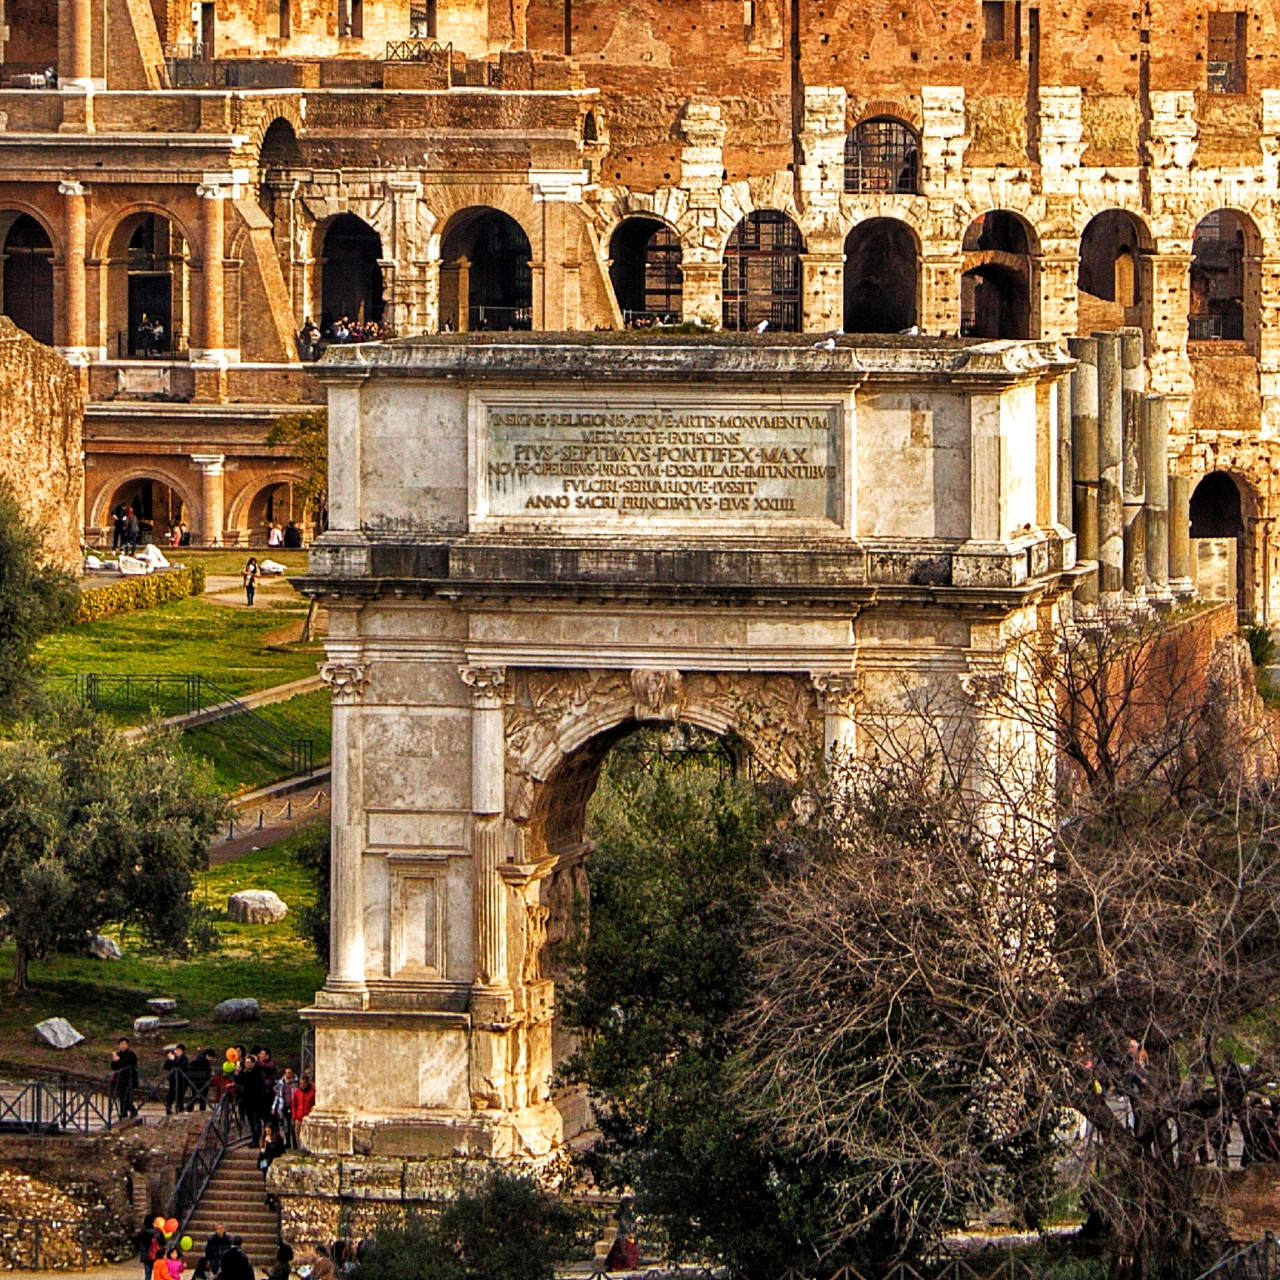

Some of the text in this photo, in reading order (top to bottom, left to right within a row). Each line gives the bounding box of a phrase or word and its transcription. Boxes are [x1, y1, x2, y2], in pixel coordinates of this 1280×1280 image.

[492, 413, 829, 430] INSIGNE RELIGIONIS ATQVE ARTIS MONVMENTVM
[581, 431, 741, 445] VETVSTATE FATISCENS
[514, 445, 808, 463] PIVS SEPTIMVS PONTIFEX MAX
[488, 462, 836, 479] NOVIS OPERIBVS PRISCVM EXEMPLAR IMITANTIBVS
[563, 480, 619, 493] FVLCIRI
[712, 481, 758, 495] IVSSIT
[525, 496, 570, 509] ANNO
[575, 496, 617, 509] SACRI
[622, 497, 712, 510] PRINCIPATVS
[719, 498, 750, 511] EIVS
